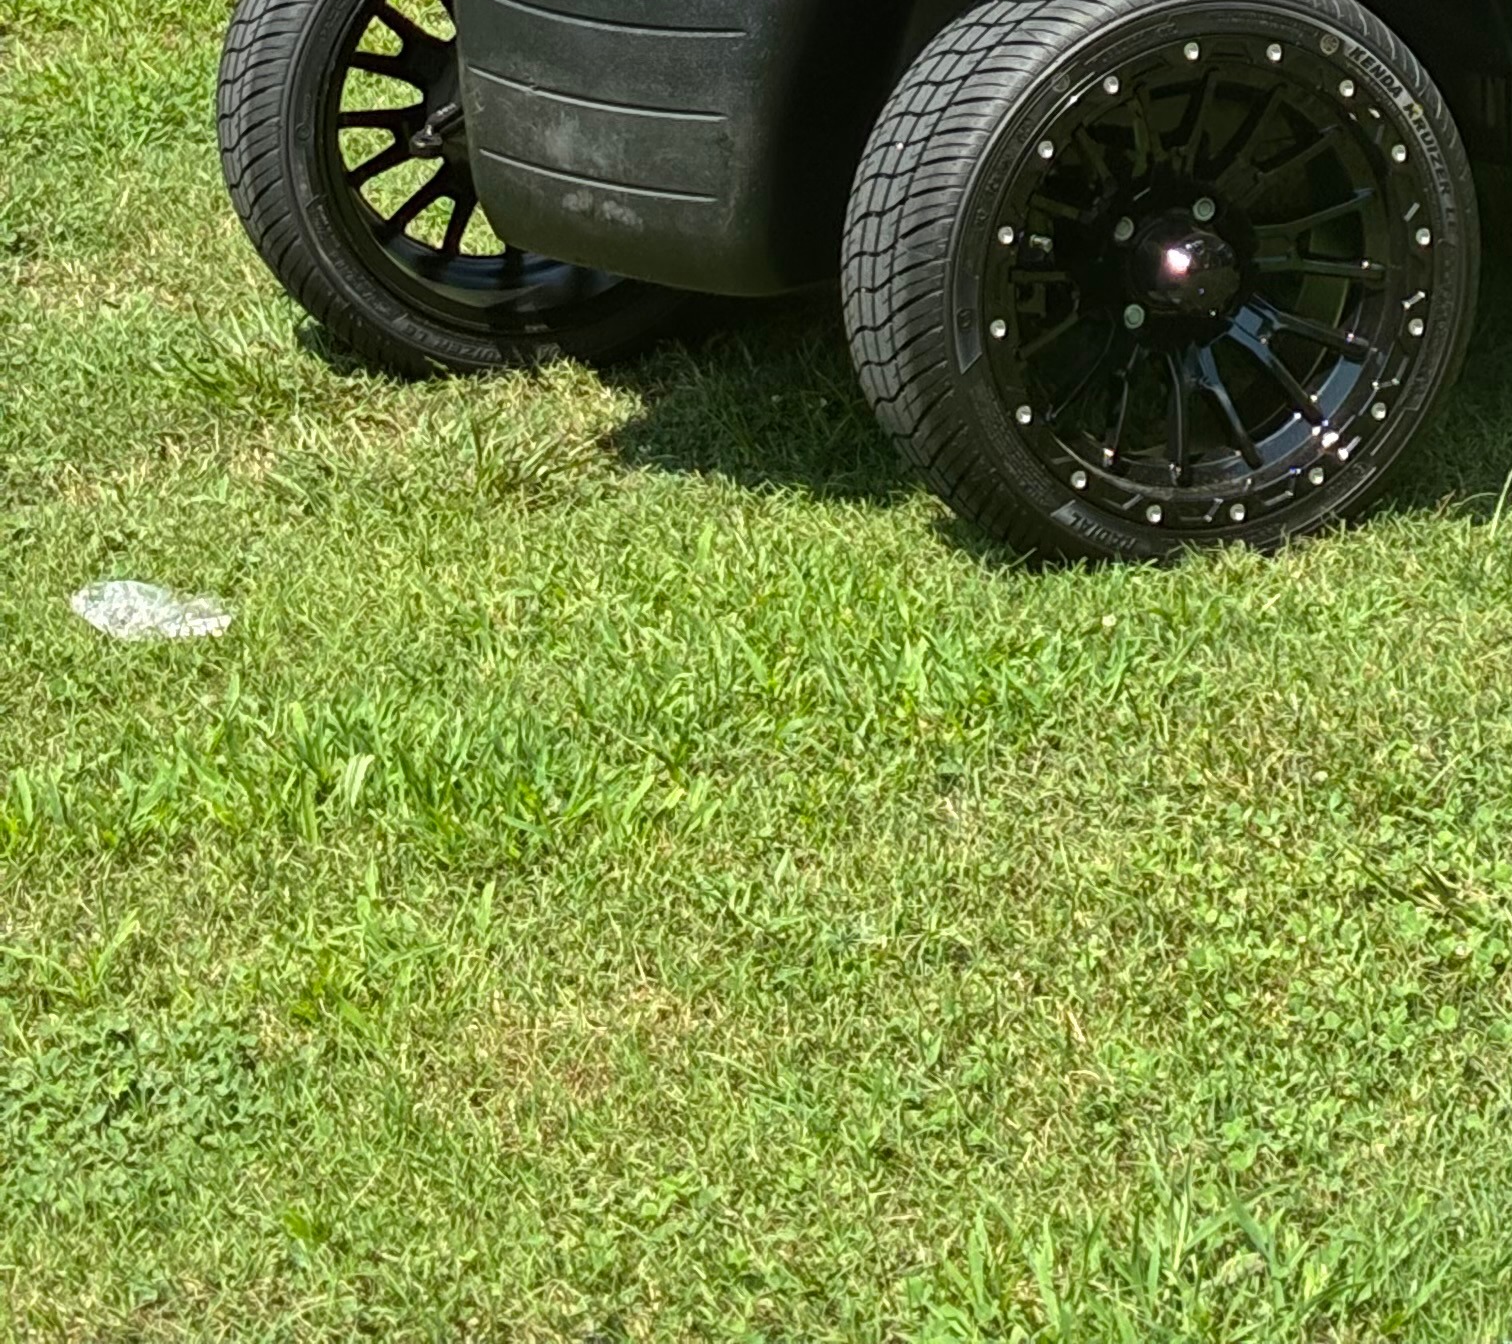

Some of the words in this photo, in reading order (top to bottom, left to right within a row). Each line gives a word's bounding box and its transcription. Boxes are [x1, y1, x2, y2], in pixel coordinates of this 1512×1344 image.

[1349, 47, 1403, 98] KENDA
[1403, 102, 1452, 196] KRUIZER
[1066, 511, 1138, 549] RADIAL
